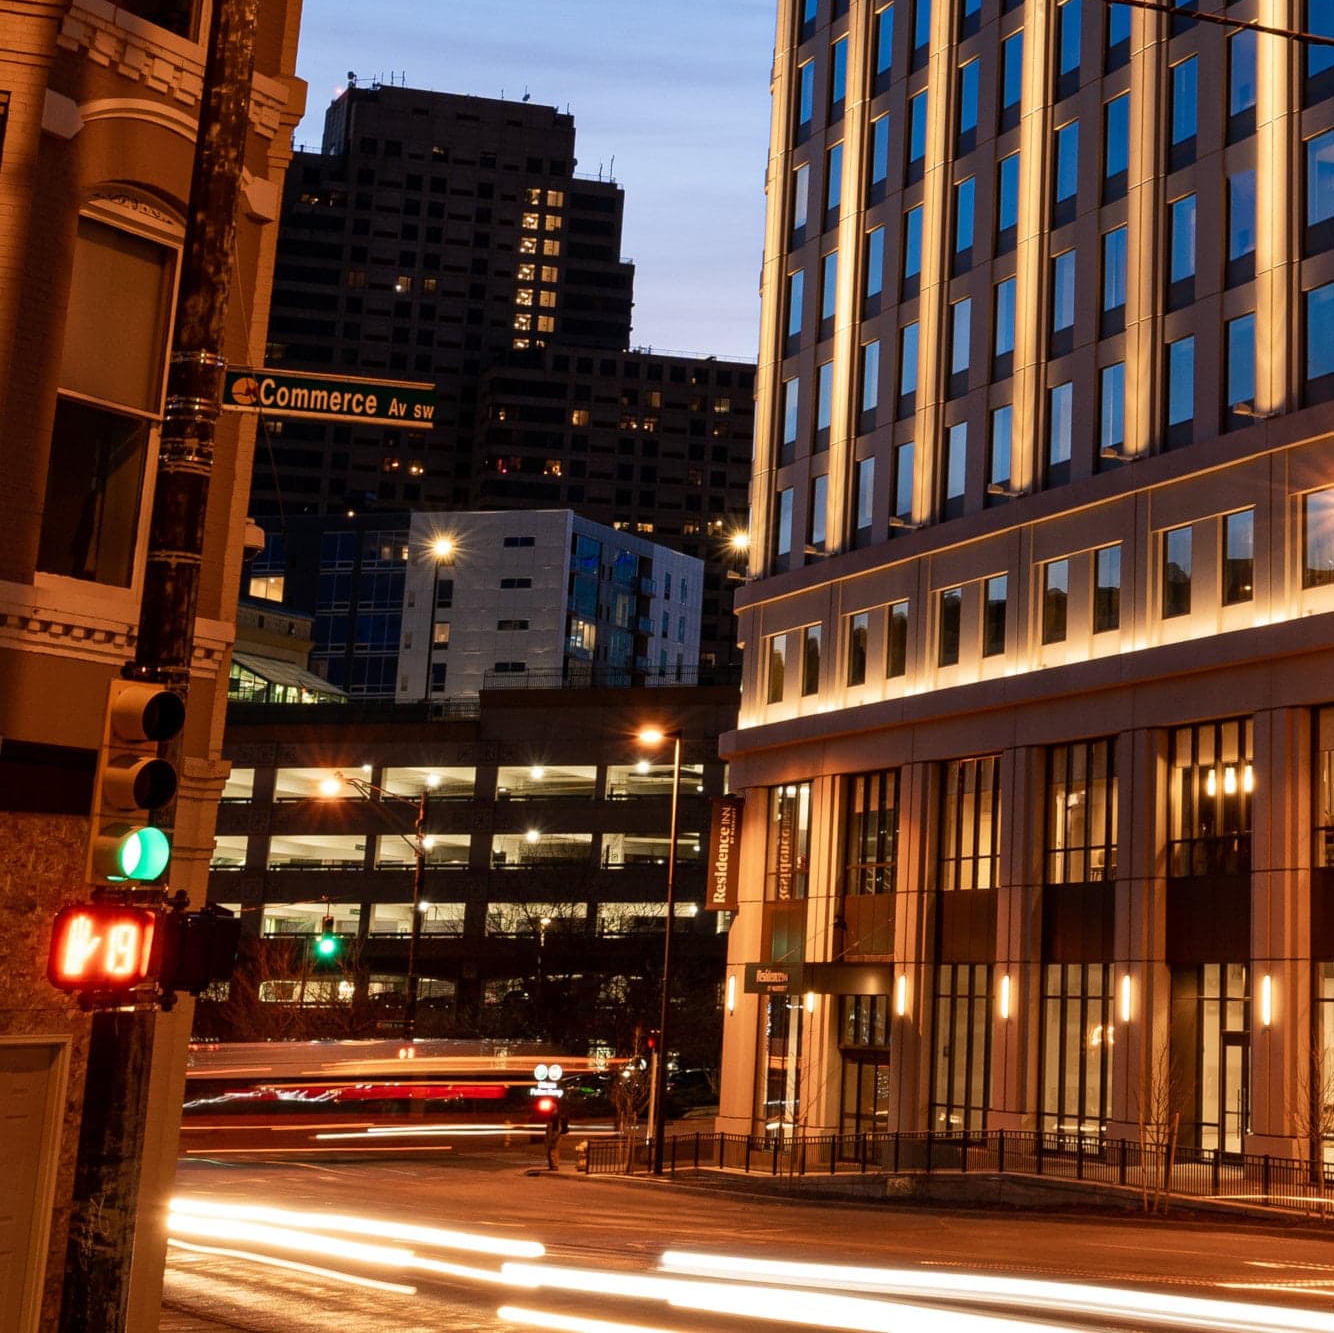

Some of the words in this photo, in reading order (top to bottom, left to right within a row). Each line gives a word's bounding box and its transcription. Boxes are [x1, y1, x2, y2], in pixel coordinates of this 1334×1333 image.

[260, 378, 377, 414] Commerce
[388, 398, 407, 417] Av
[721, 807, 732, 825] INN
[713, 826, 730, 903] Residence
